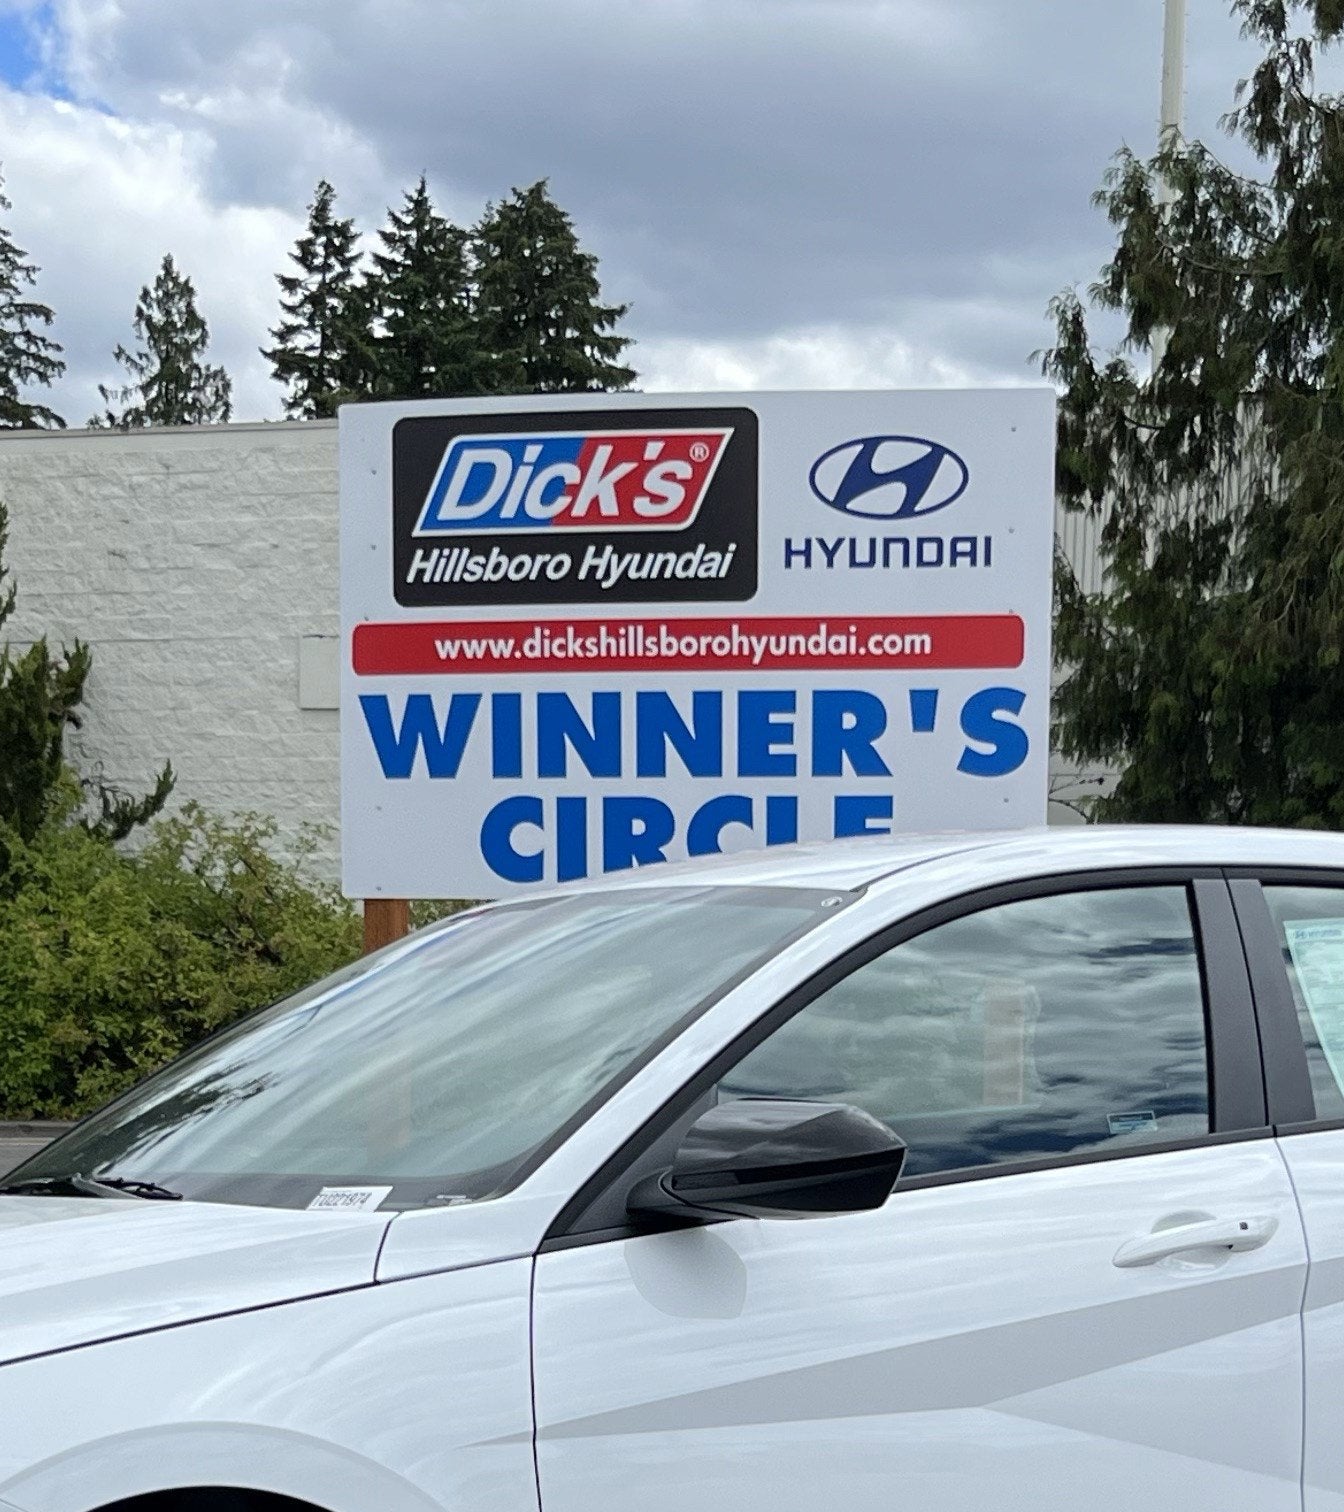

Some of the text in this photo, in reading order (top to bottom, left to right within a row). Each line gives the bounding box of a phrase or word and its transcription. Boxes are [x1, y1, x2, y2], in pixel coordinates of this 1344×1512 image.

[437, 439, 694, 522] Dick's
[406, 543, 738, 589] Hillsboro Hyundai
[784, 535, 993, 570] HYUNDAI
[434, 624, 932, 664] www.dickshillsborohyundai.com
[358, 686, 1030, 779] WINNER'S
